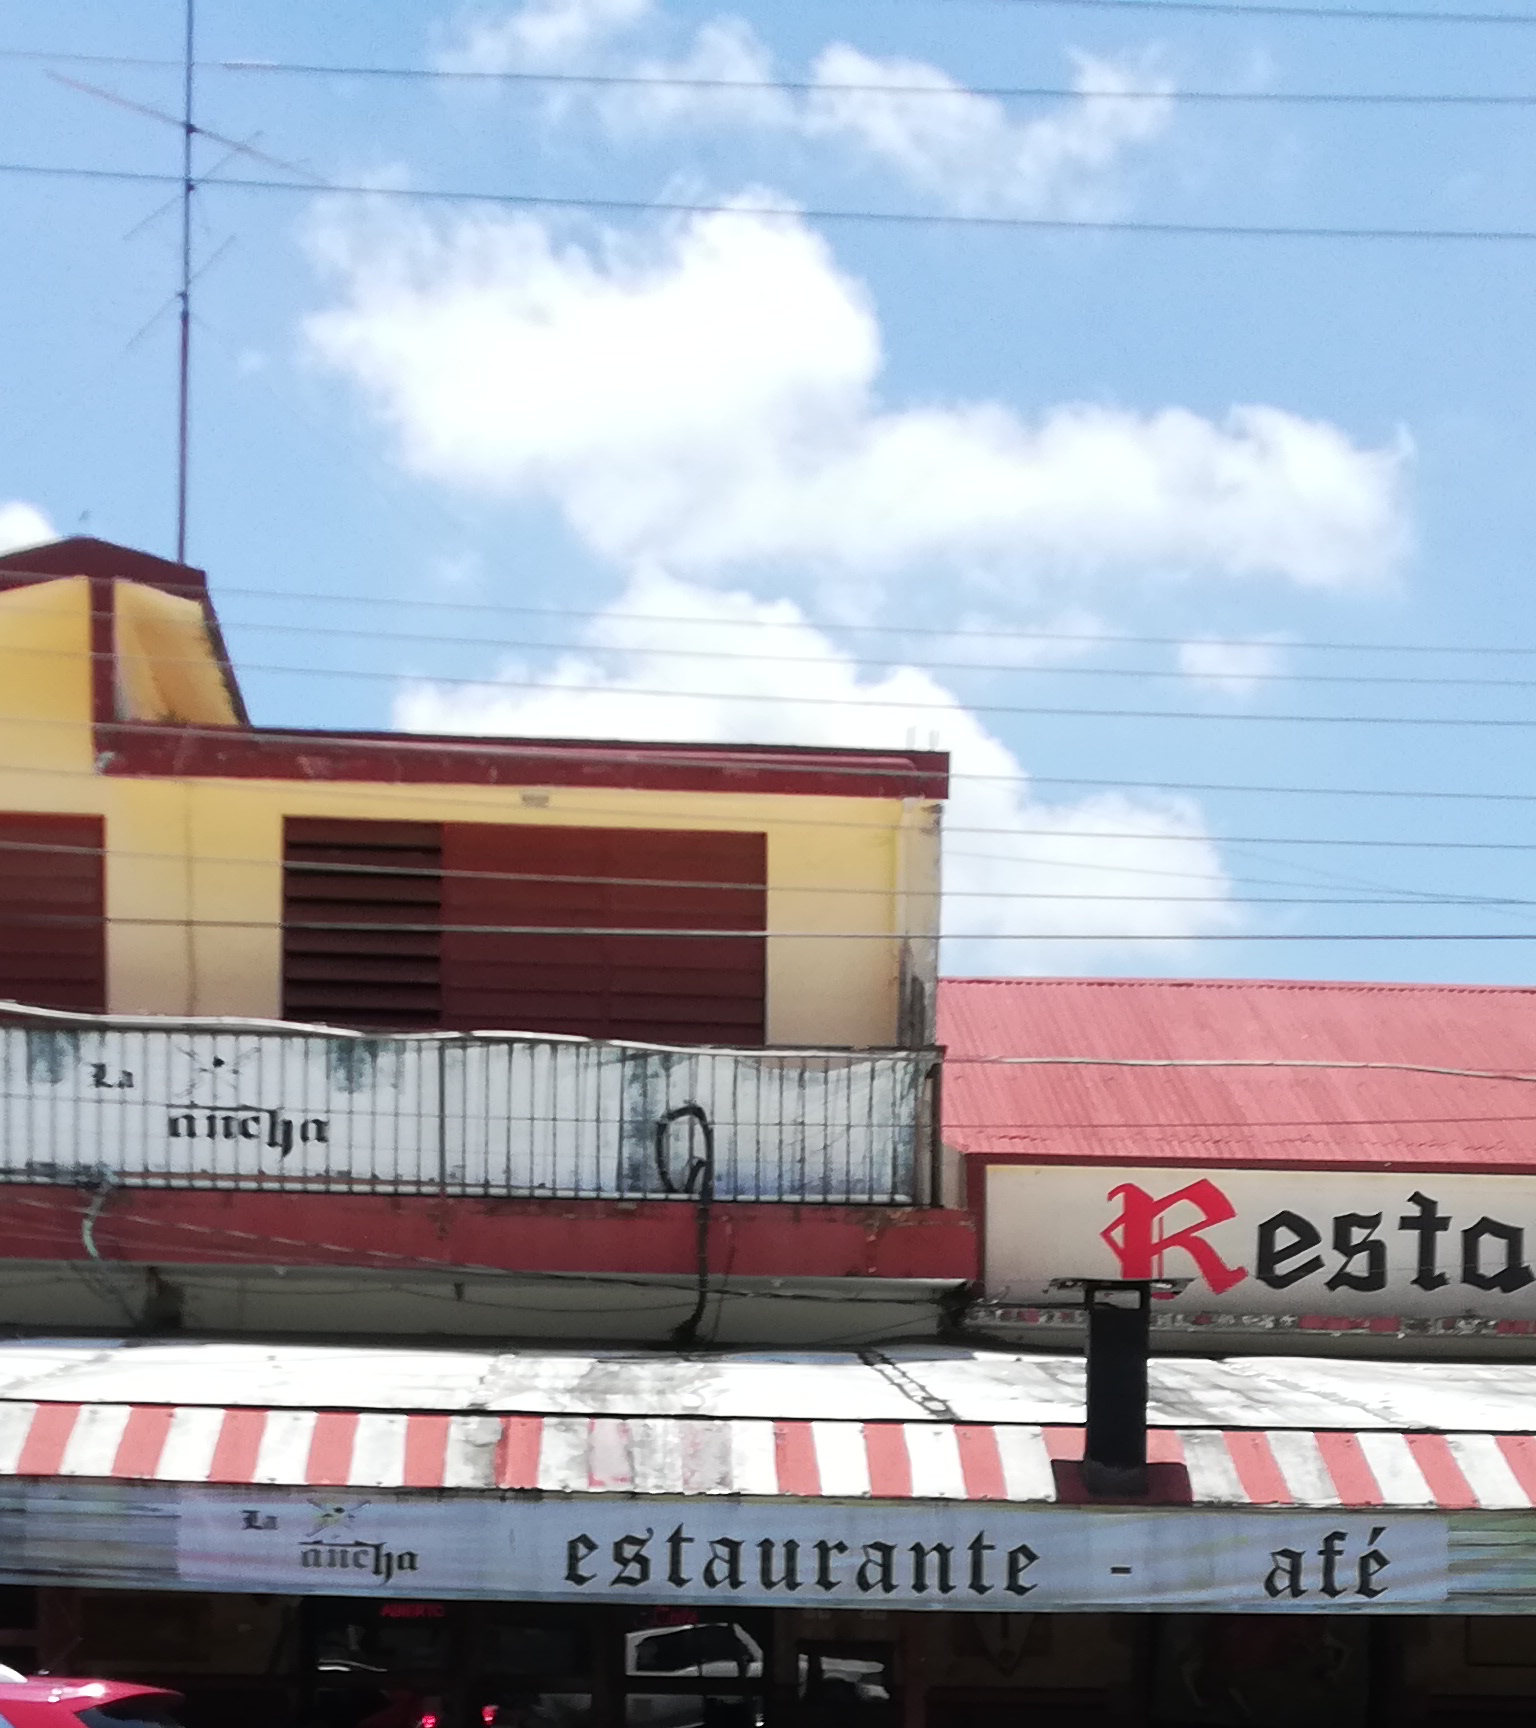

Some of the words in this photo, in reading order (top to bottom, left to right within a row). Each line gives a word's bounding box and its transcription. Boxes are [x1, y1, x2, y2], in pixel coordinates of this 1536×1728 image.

[90, 1062, 135, 1089] La
[241, 1509, 279, 1531] La
[565, 1523, 1041, 1597] estaurante
